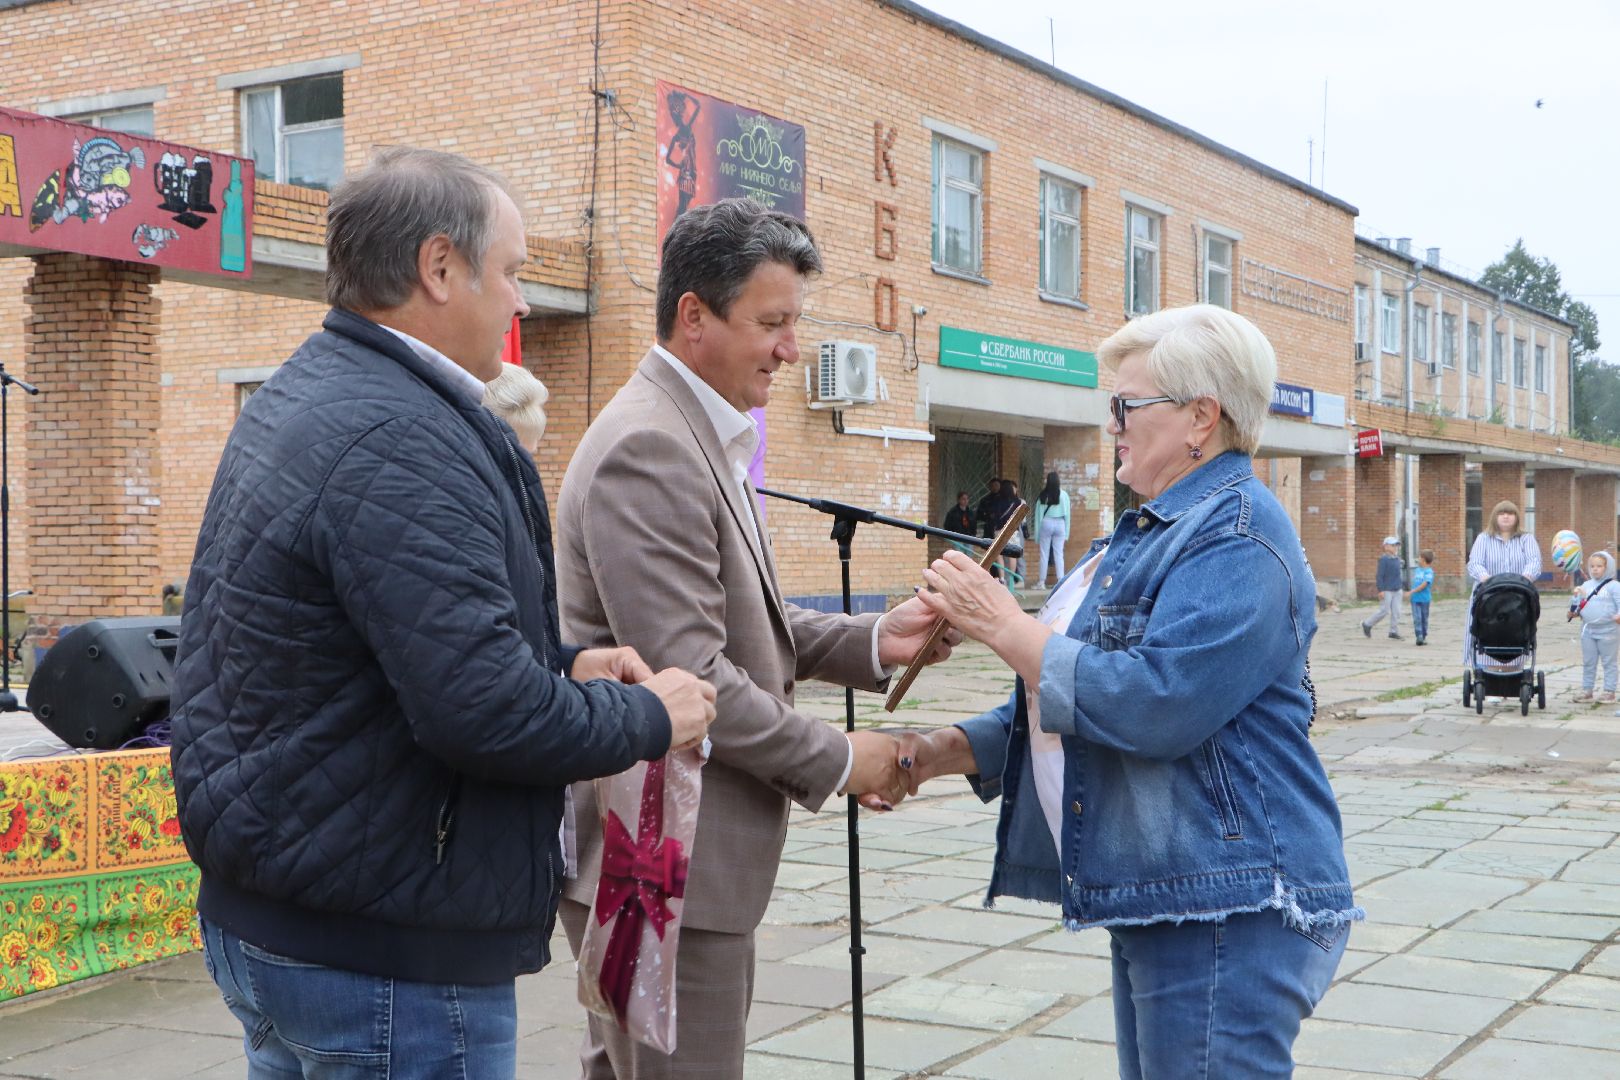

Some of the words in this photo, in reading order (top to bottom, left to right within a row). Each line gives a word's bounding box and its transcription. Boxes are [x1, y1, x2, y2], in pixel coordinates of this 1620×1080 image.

[720, 162, 737, 176] МИР
[988, 341, 1031, 361] СБЕРБАНК
[1033, 350, 1065, 367] РОССИИ
[1280, 389, 1302, 409] РОССИИ
[1359, 435, 1379, 445] ПОЧТА
[1360, 443, 1377, 452] БАНК
